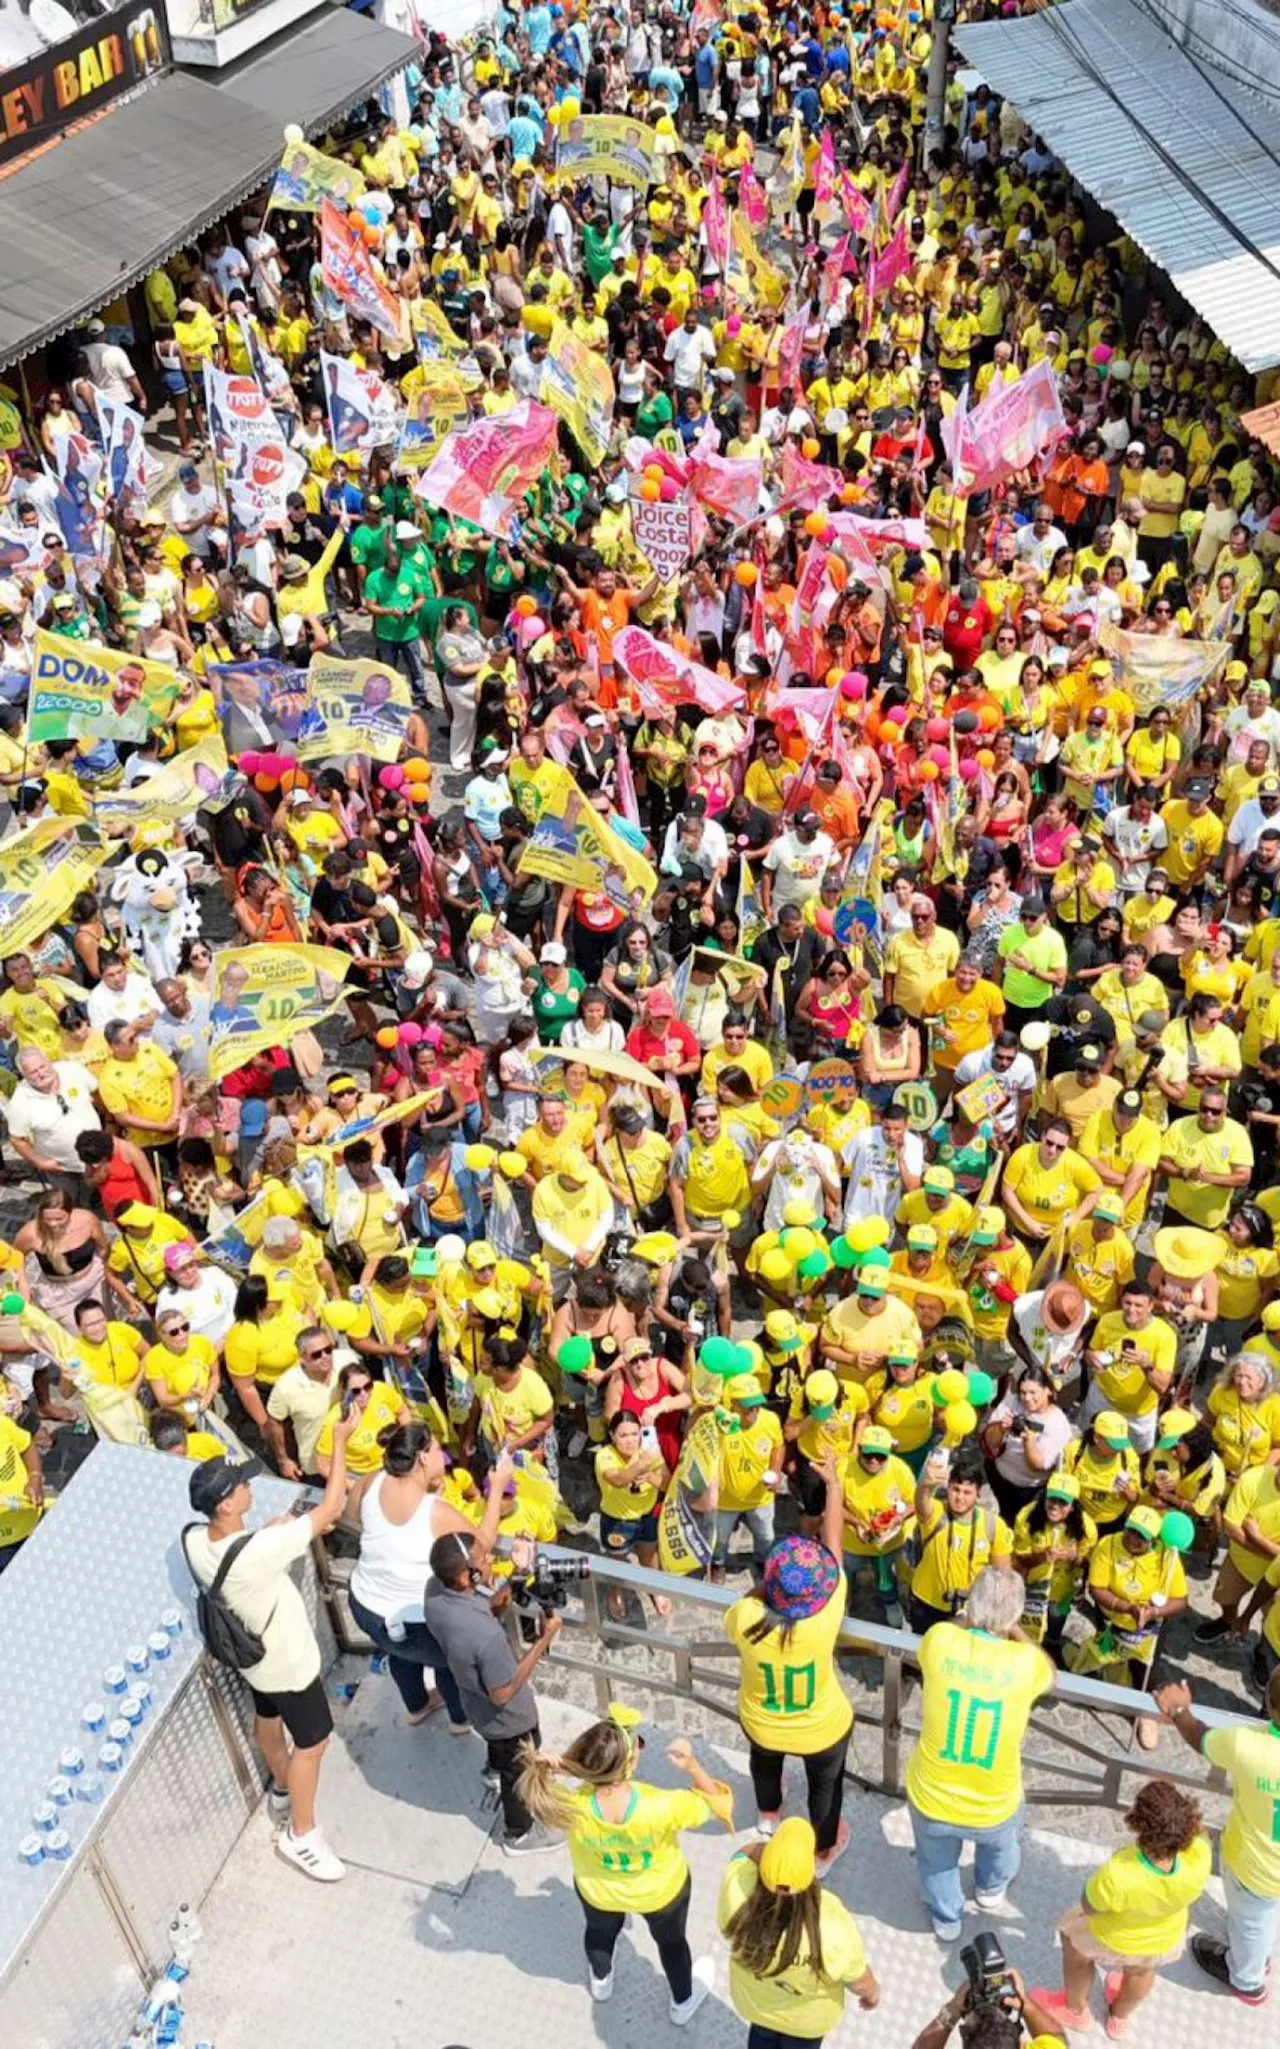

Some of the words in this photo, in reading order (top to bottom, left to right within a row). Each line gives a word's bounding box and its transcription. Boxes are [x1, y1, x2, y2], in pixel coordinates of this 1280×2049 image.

[54, 34, 124, 108] BAR
[595, 141, 612, 153] 10
[436, 418, 449, 434] 10
[635, 503, 687, 527] Joice
[636, 522, 688, 546] Costa
[644, 544, 687, 563] 77007
[38, 653, 110, 688] DOM
[320, 700, 344, 719] 10
[11, 858, 39, 887] 10
[266, 998, 294, 1021] 10
[763, 1085, 789, 1106] 10
[901, 1091, 928, 1119] 10
[1035, 1196, 1050, 1210] 10
[758, 1660, 815, 1714] 10
[939, 1688, 1003, 1771] 10
